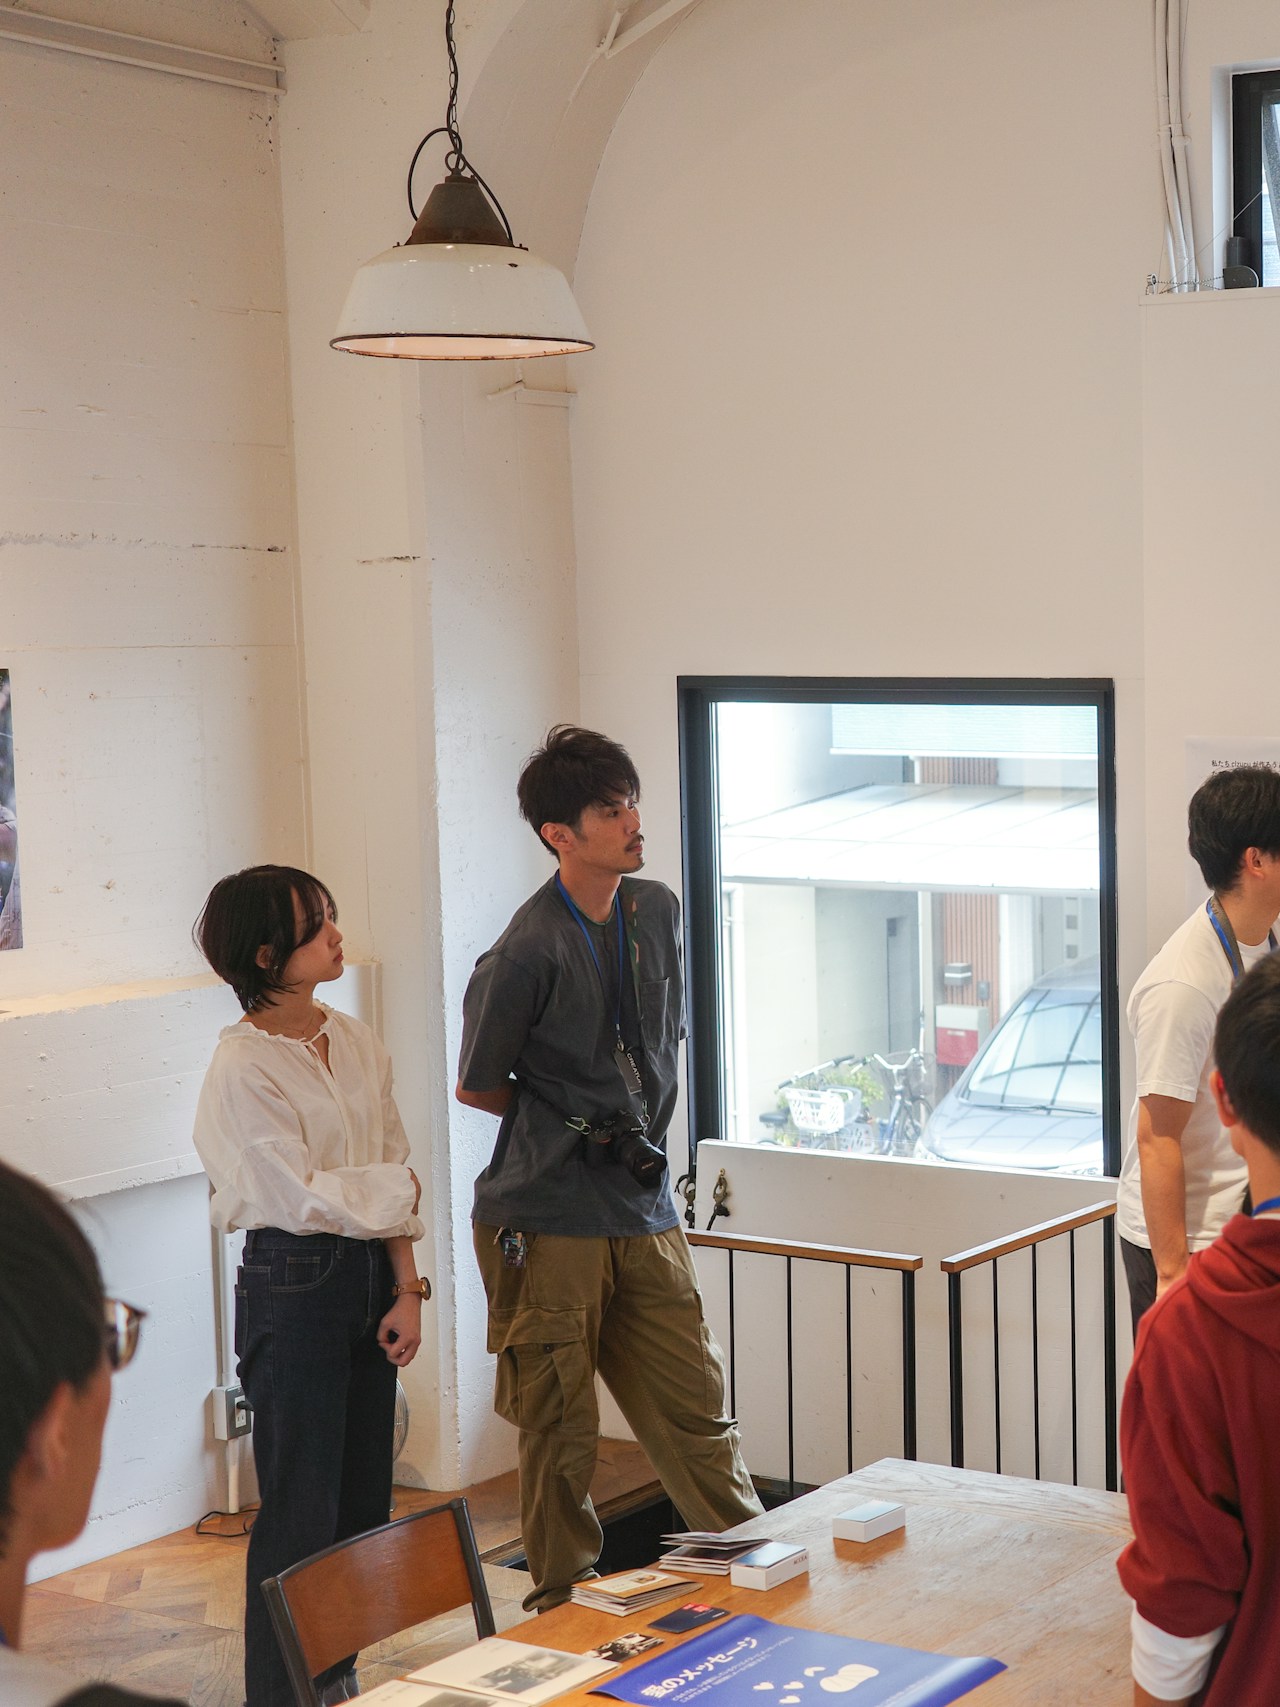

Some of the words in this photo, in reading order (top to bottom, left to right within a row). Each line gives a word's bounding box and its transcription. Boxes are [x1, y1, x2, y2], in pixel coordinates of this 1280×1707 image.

[641, 1637, 758, 1699] 愛のメッセージ
